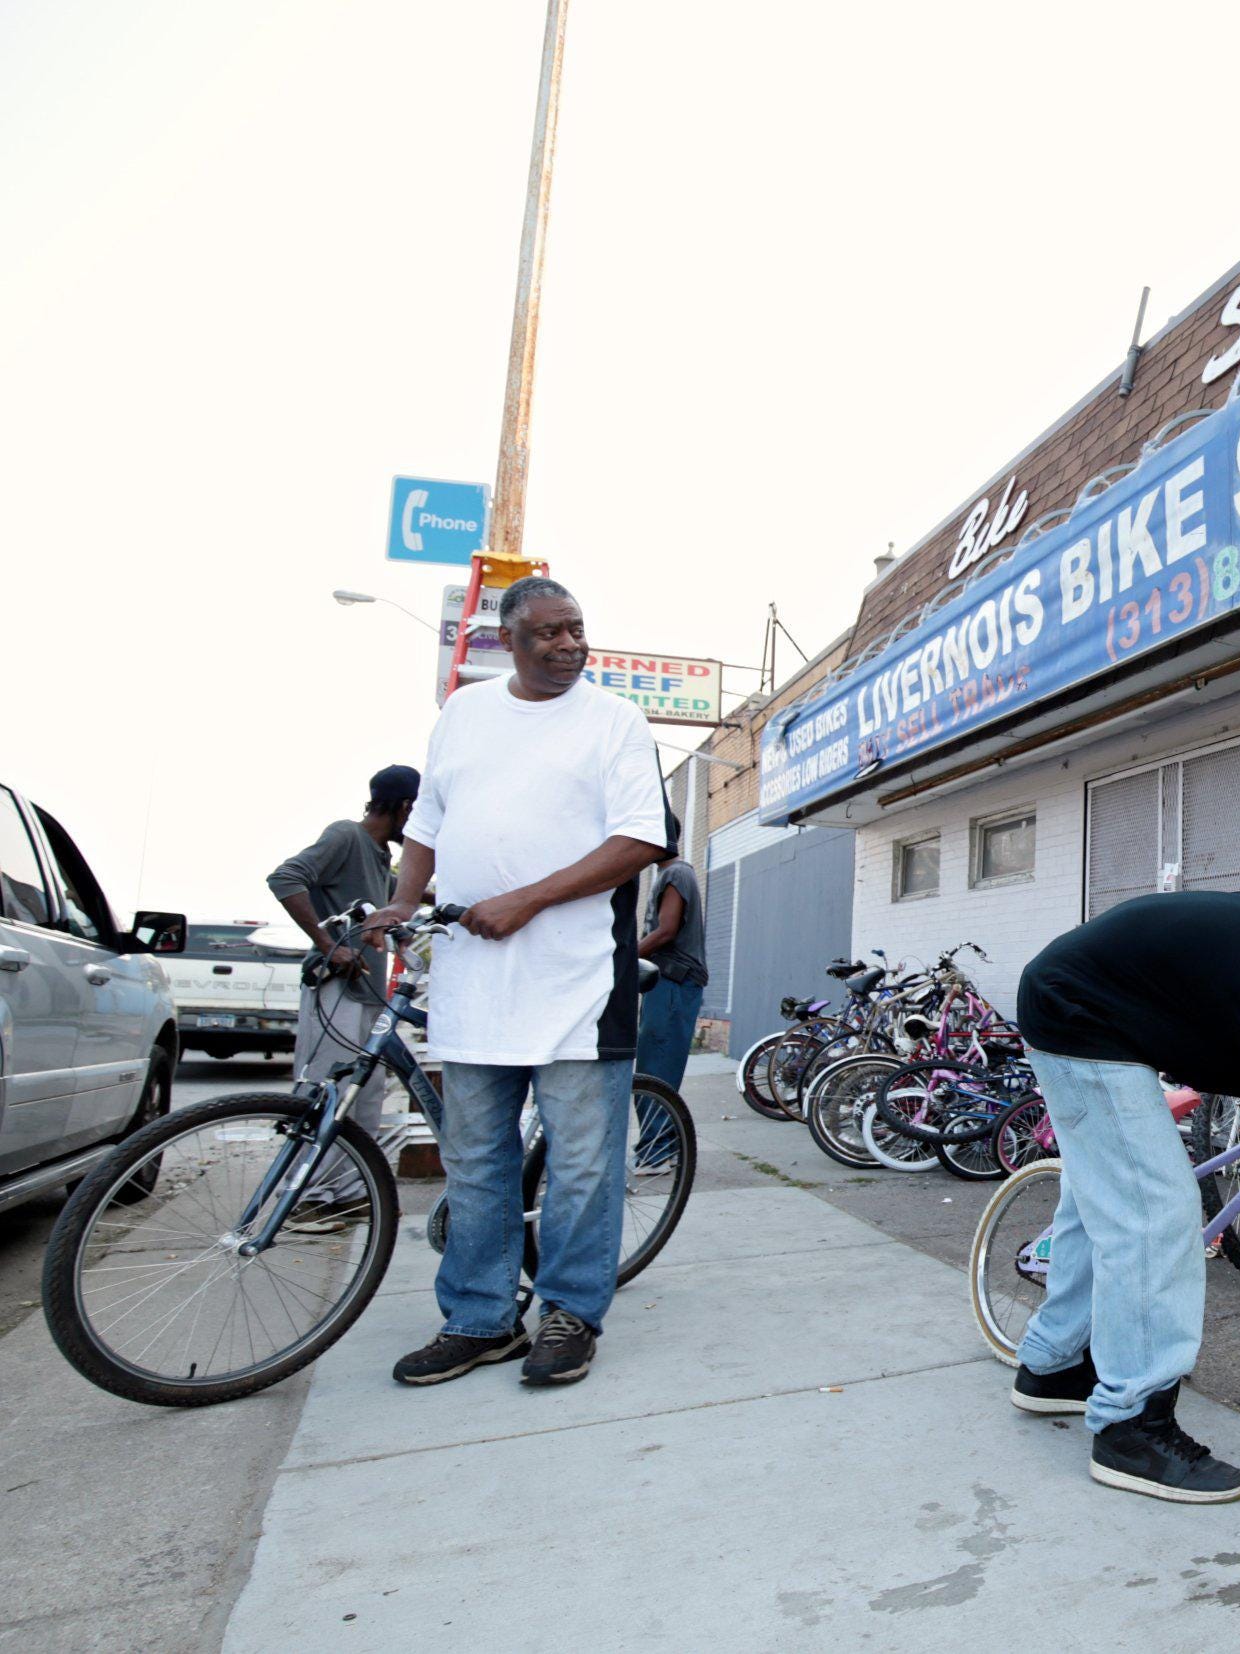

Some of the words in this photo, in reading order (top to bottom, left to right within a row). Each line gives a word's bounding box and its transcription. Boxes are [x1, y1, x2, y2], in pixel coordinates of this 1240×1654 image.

[419, 512, 478, 532] Phone
[857, 568, 1044, 738] LIVERNOIS
[1060, 455, 1208, 625] BIKE
[665, 709, 710, 720] BAKERY
[815, 697, 849, 742] BIKES
[895, 700, 945, 754] SELL
[818, 735, 850, 778] RIDERS
